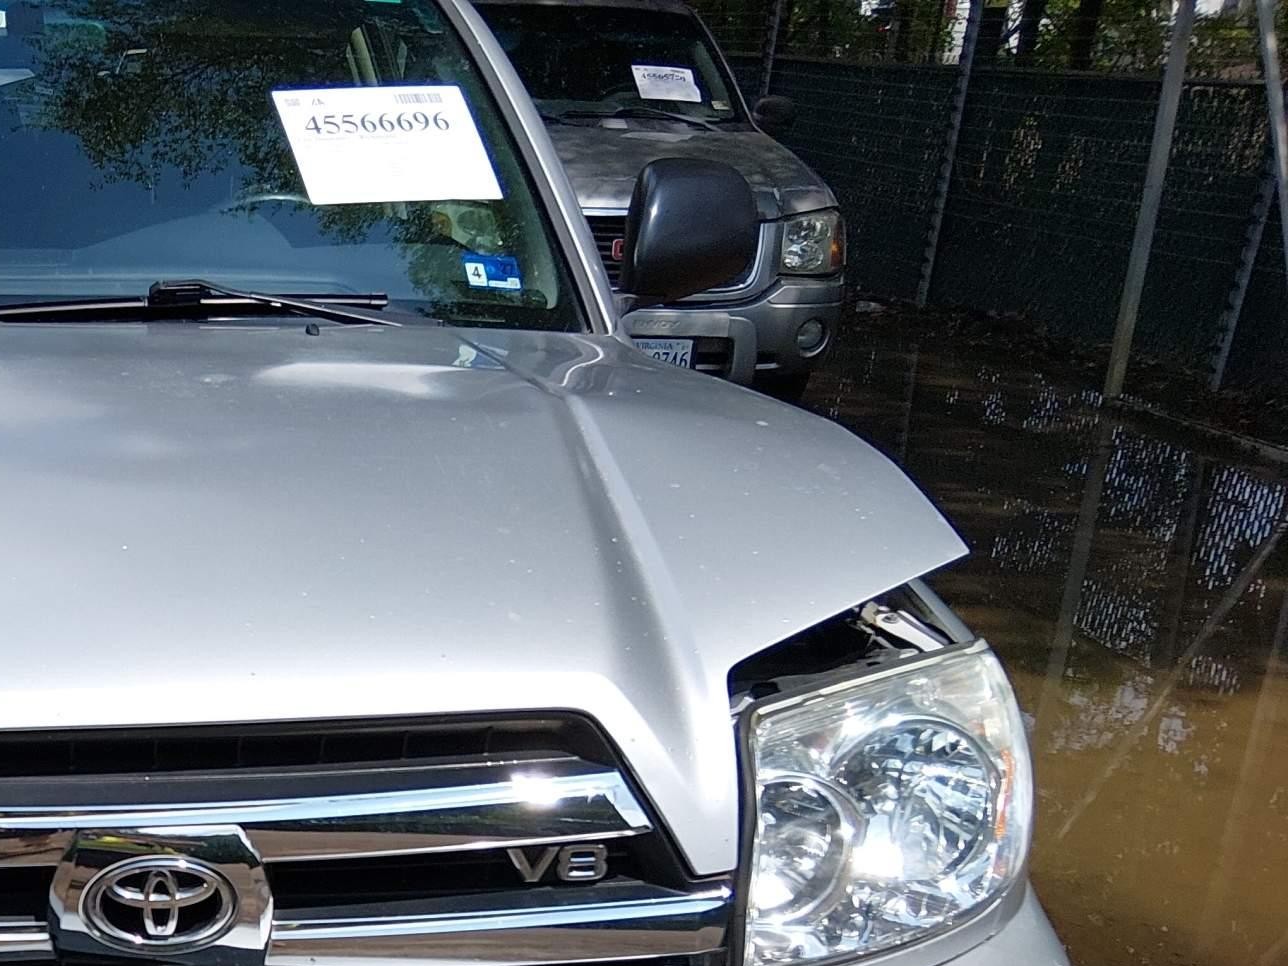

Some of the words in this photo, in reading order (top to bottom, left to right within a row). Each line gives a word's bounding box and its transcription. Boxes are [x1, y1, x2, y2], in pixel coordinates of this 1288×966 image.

[305, 111, 450, 135] 45566696
[472, 266, 482, 279] 4
[636, 342, 673, 351] VIRGINIA
[506, 843, 608, 882] V8
